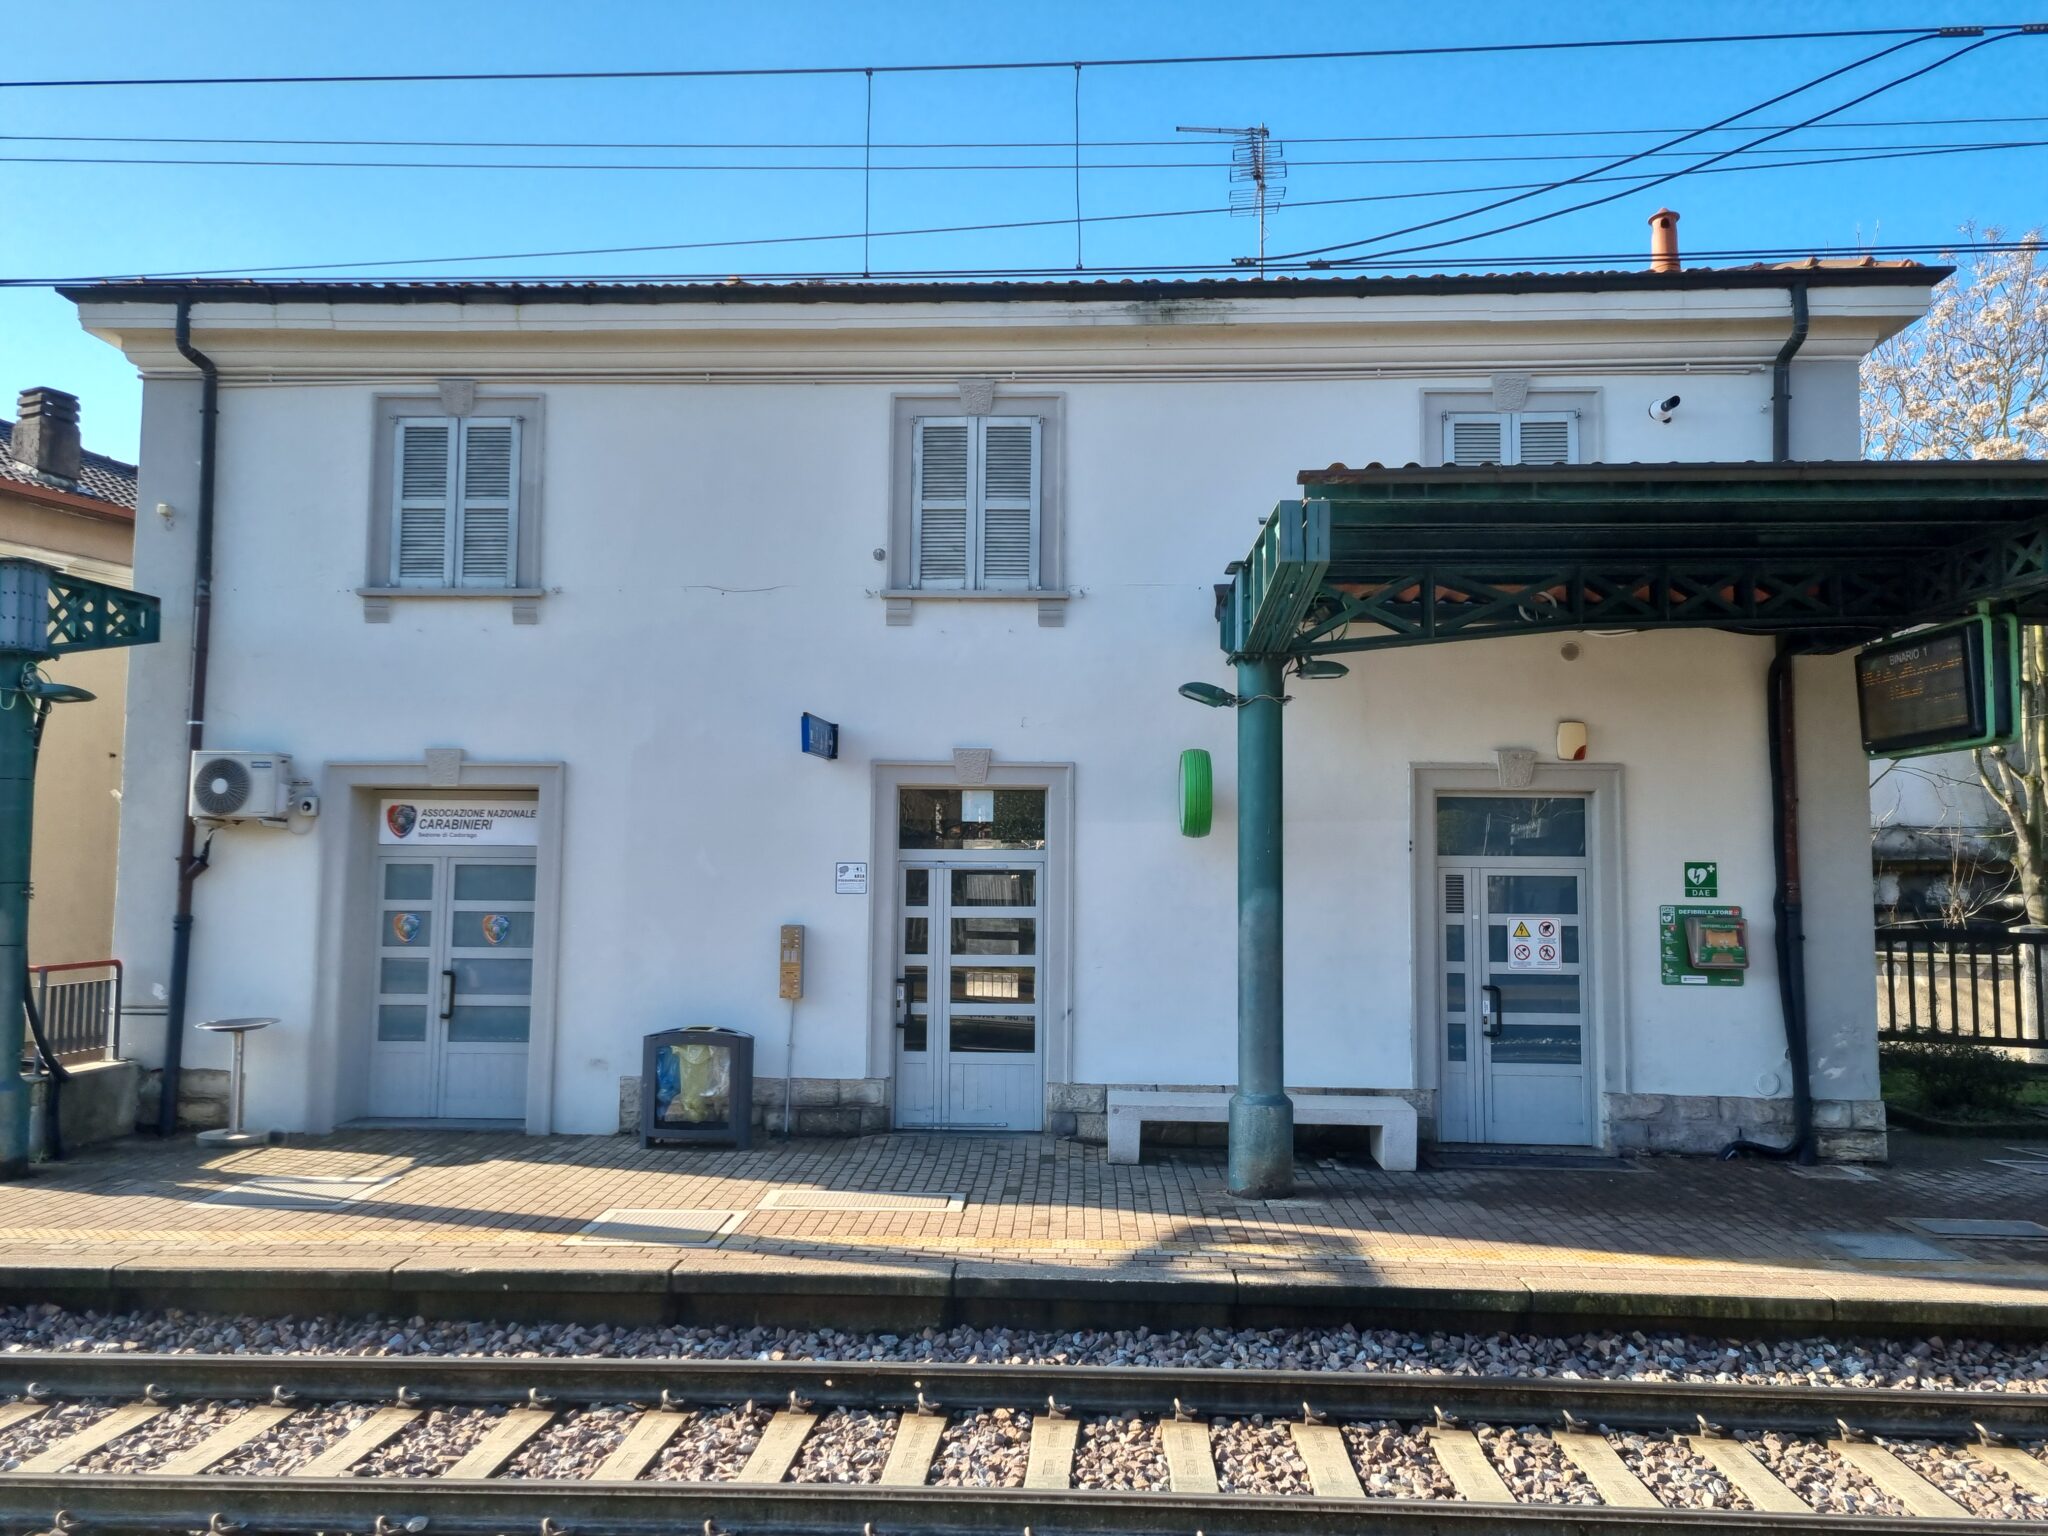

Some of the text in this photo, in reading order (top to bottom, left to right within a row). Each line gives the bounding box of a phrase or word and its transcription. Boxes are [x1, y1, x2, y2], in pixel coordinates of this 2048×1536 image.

[1889, 647, 1928, 666] BINARIO 1
[421, 809, 536, 818] ASSOCIAZIONE NAZIONALE
[419, 819, 493, 830] CARABINIERI
